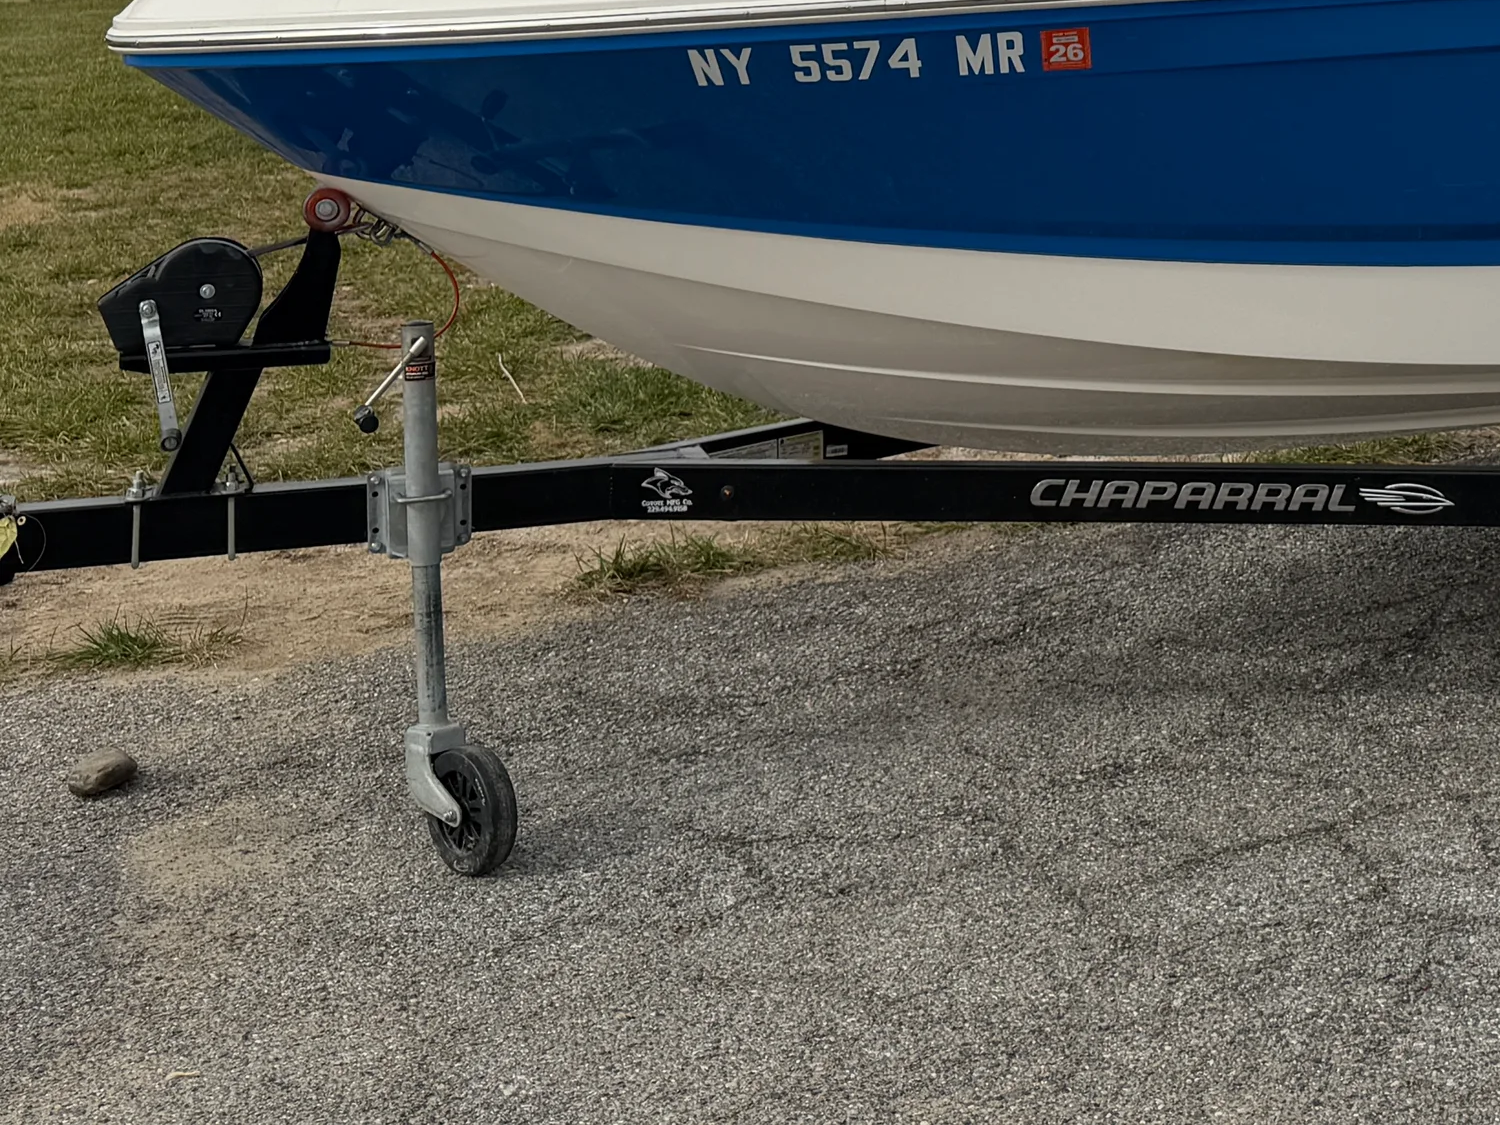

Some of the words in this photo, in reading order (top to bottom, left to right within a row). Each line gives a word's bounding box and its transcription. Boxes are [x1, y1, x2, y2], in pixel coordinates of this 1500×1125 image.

[687, 47, 752, 87] NY
[789, 38, 922, 83] 5574
[955, 31, 1026, 76] MR
[1049, 43, 1084, 63] 26
[1030, 478, 1356, 513] CHAPARRAL
